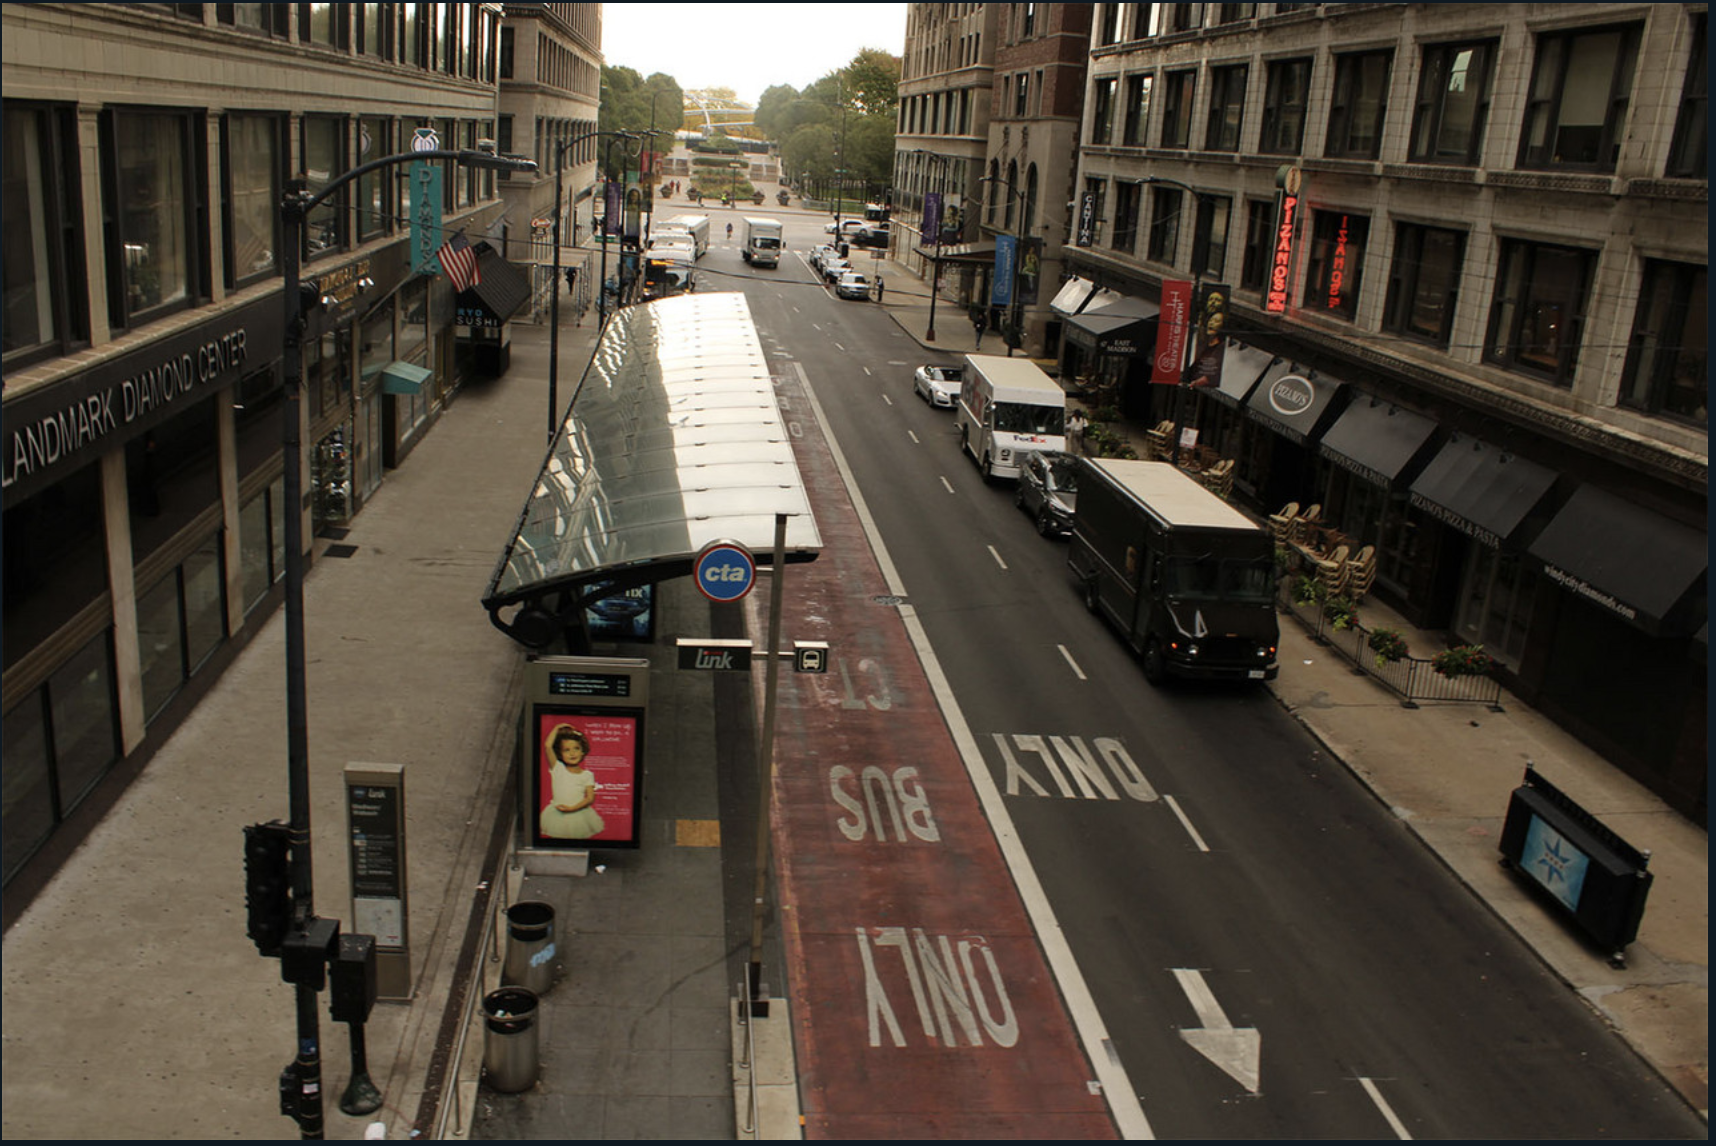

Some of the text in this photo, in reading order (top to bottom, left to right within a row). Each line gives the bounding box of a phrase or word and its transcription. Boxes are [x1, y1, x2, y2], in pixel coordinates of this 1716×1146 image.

[418, 168, 433, 262] DIAMONDS
[1079, 195, 1093, 243] CANTINA
[456, 309, 483, 317] RYO
[456, 316, 499, 328] SUSHI
[1106, 345, 1138, 354] MADISON
[1114, 338, 1132, 346] EAST
[2, 328, 248, 488] LANDMARK DIAMOND CENTER
[1013, 434, 1047, 444] FedEx
[1443, 509, 1465, 532] PIZZA
[1474, 525, 1500, 550] PASTA
[705, 563, 745, 582] cta
[1544, 564, 1637, 620] windycitydiamonds.com
[992, 732, 1159, 802] ONLY
[829, 765, 941, 843] BUS
[856, 926, 1020, 1048] ONLY
